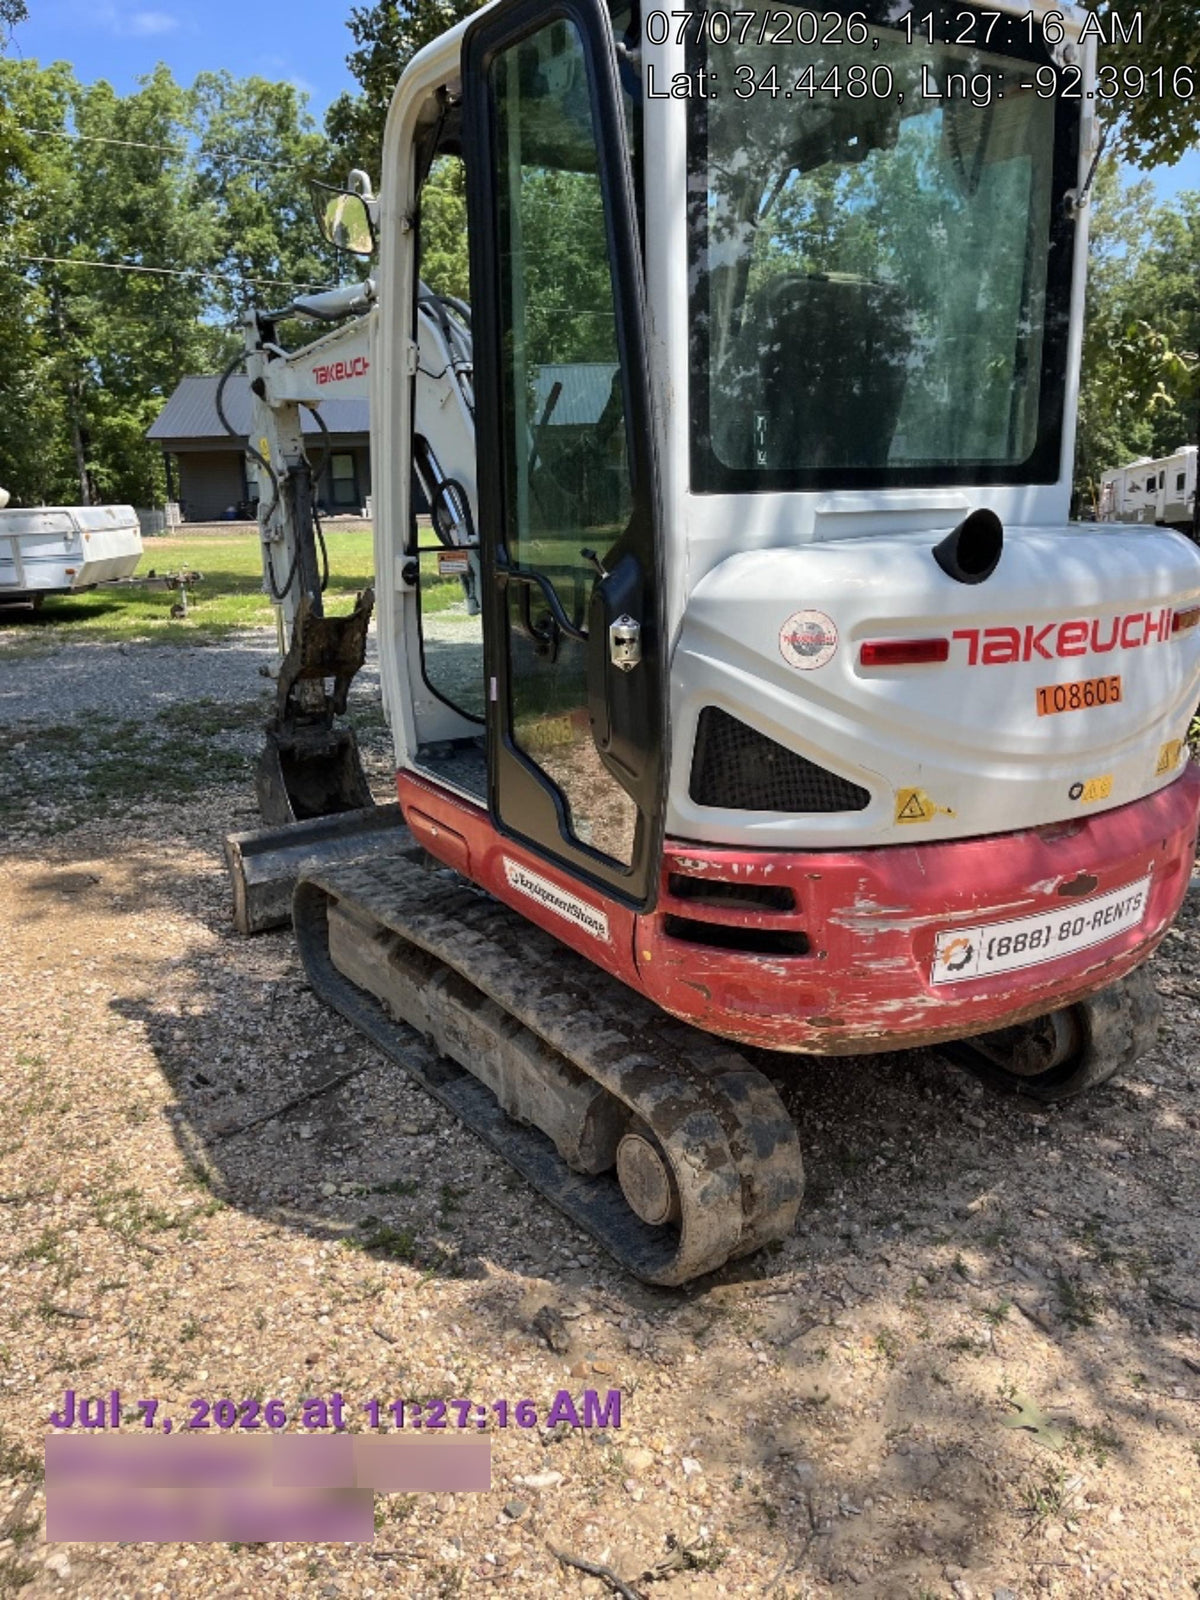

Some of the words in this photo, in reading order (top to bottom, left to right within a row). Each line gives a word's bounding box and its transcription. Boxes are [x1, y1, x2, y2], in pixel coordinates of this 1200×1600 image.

[1039, 676, 1121, 713] 108605
[986, 925, 1051, 960] (888)
[1057, 892, 1144, 942] 80-RENTS
